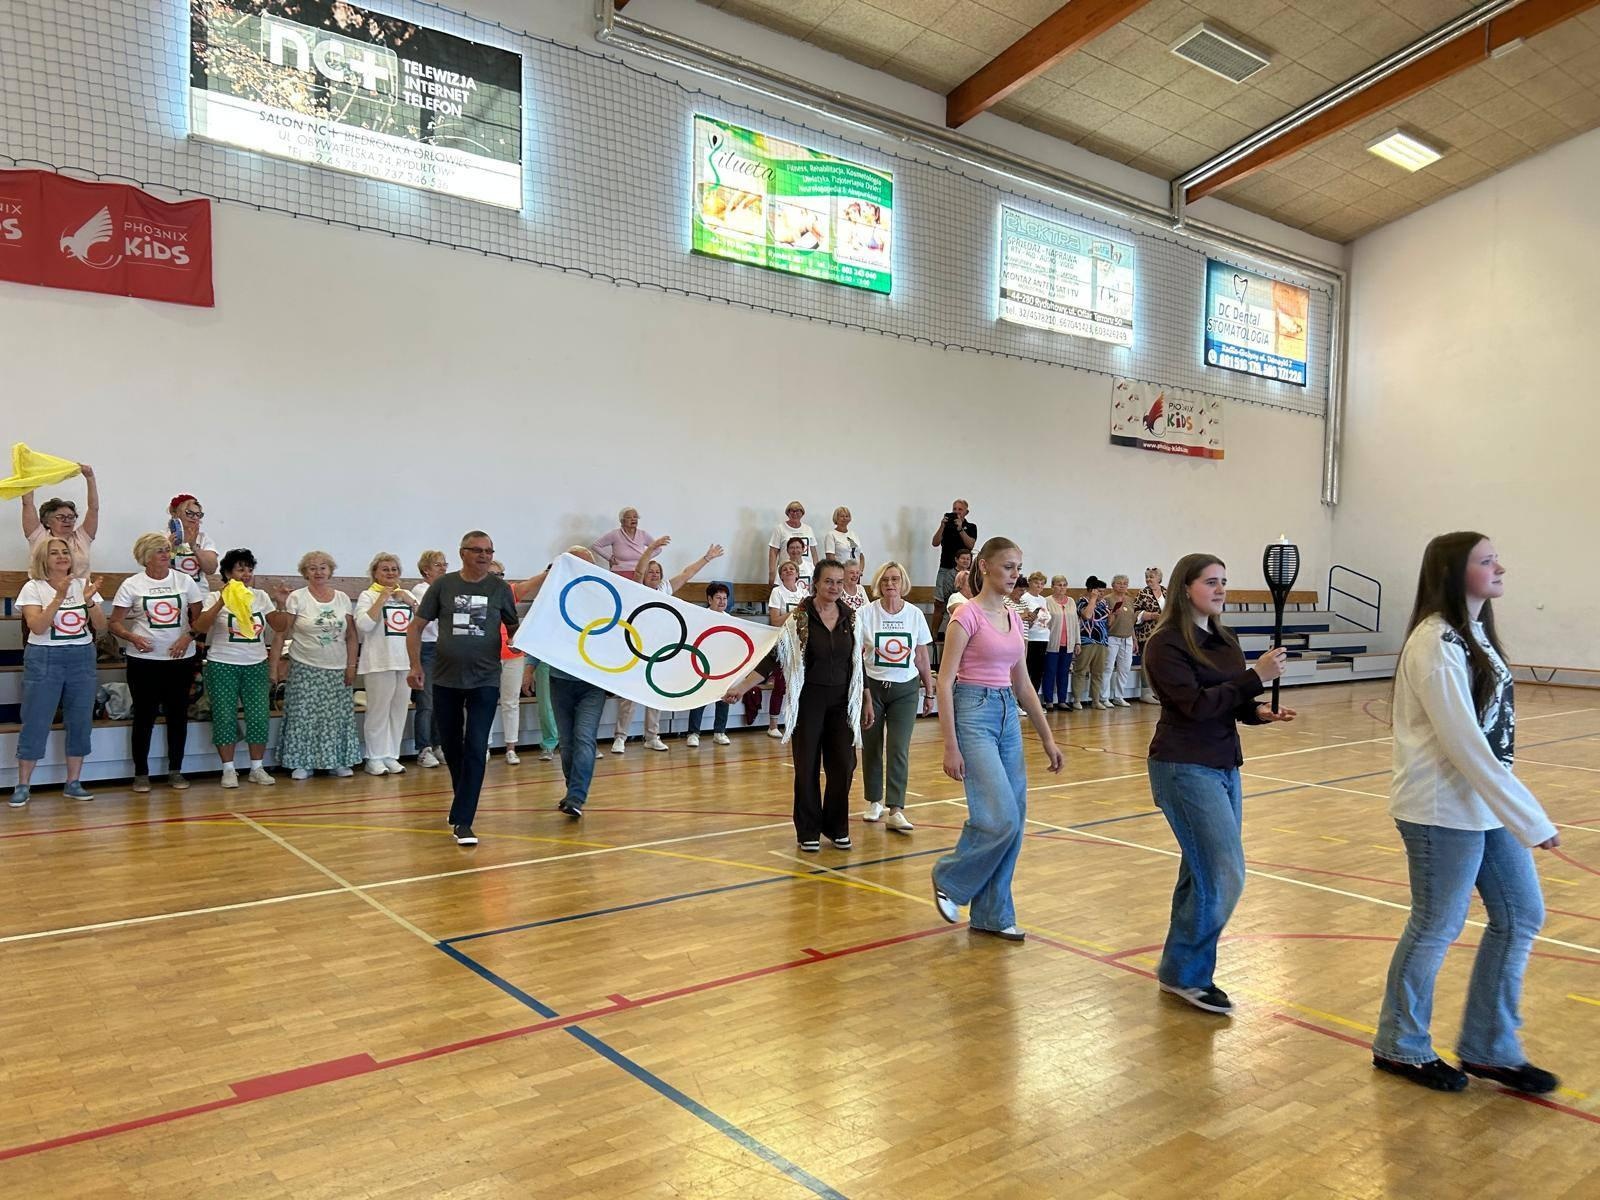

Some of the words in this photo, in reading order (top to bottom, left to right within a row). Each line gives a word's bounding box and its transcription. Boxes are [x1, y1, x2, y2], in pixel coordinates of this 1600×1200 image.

[270, 23, 389, 92] nc+
[403, 58, 477, 91] TELEWIZJA
[405, 75, 469, 104] INTERNET
[403, 91, 462, 118] TELEFON
[259, 111, 304, 130] SALON
[1219, 303, 1230, 318] DC
[1234, 308, 1261, 326] Dental
[1207, 318, 1269, 345] STOMATOLOGIA
